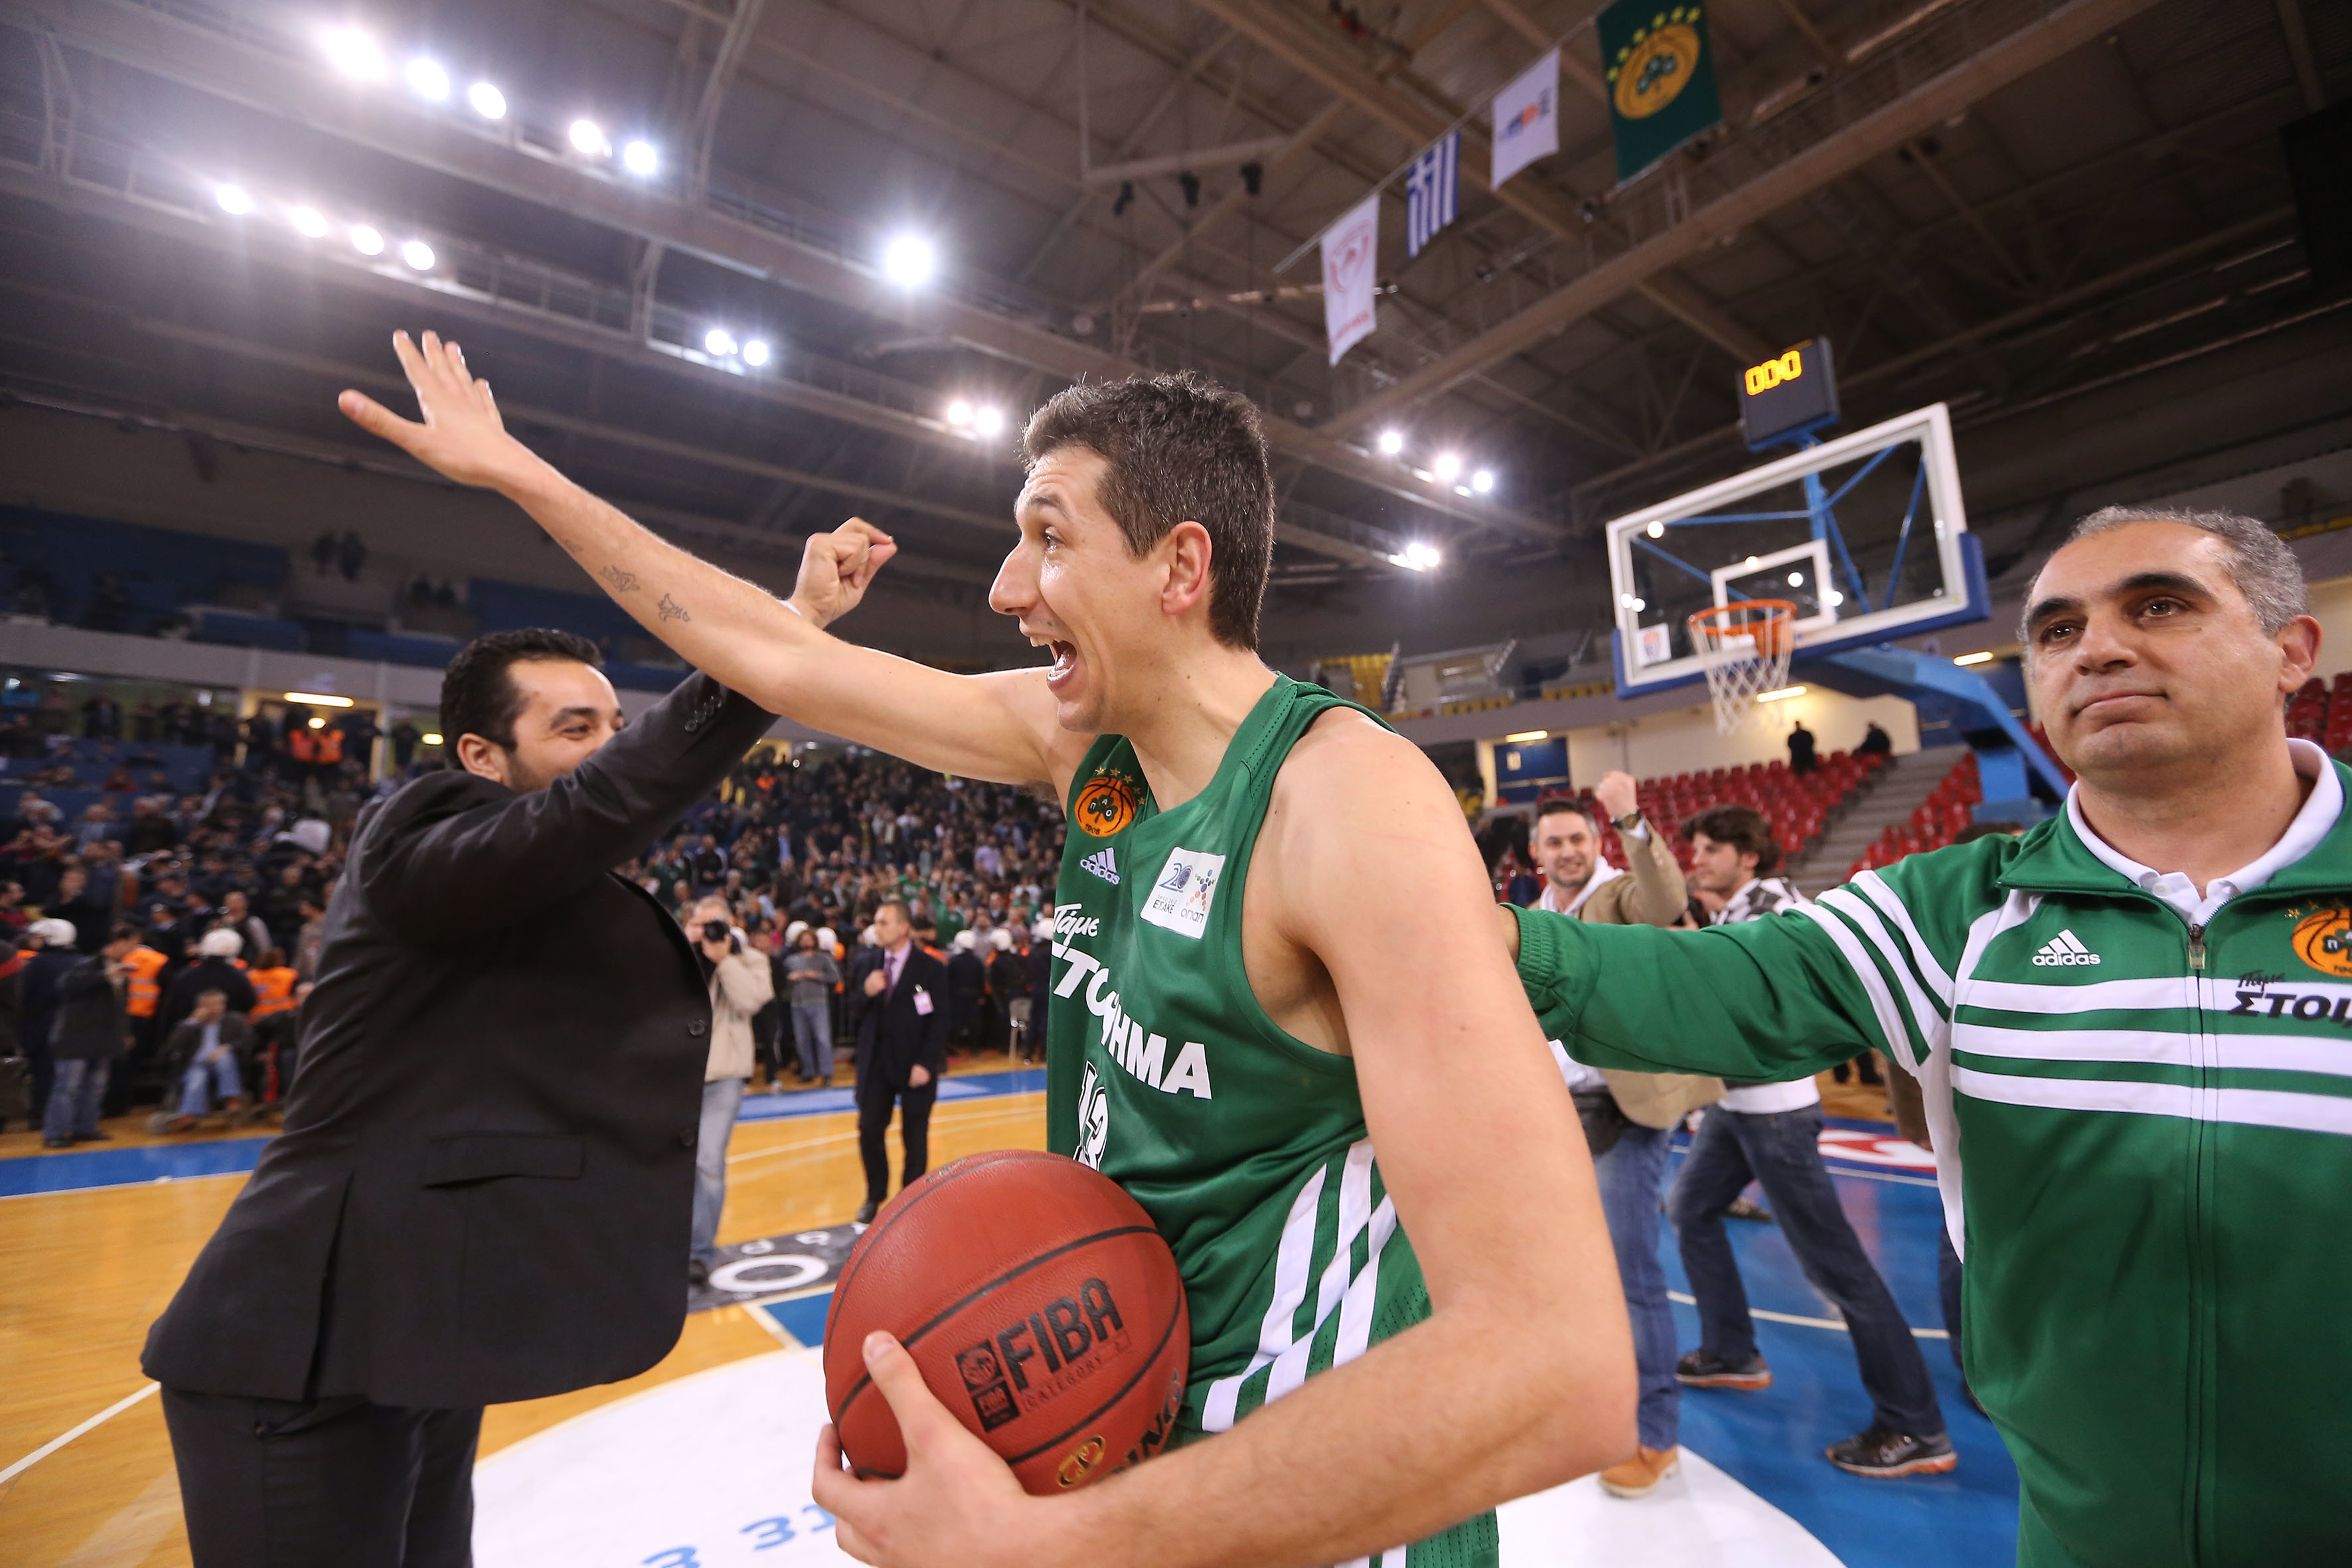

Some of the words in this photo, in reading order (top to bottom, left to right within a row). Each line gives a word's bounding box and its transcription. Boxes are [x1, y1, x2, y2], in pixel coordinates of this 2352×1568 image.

[1080, 858, 1121, 885] adidas
[1152, 899, 1175, 914] ΕΣΑΚΕ
[2032, 951, 2102, 967] adidas
[2227, 990, 2352, 1028] ΣΤΟΙ
[996, 1277, 1124, 1393] FIBA
